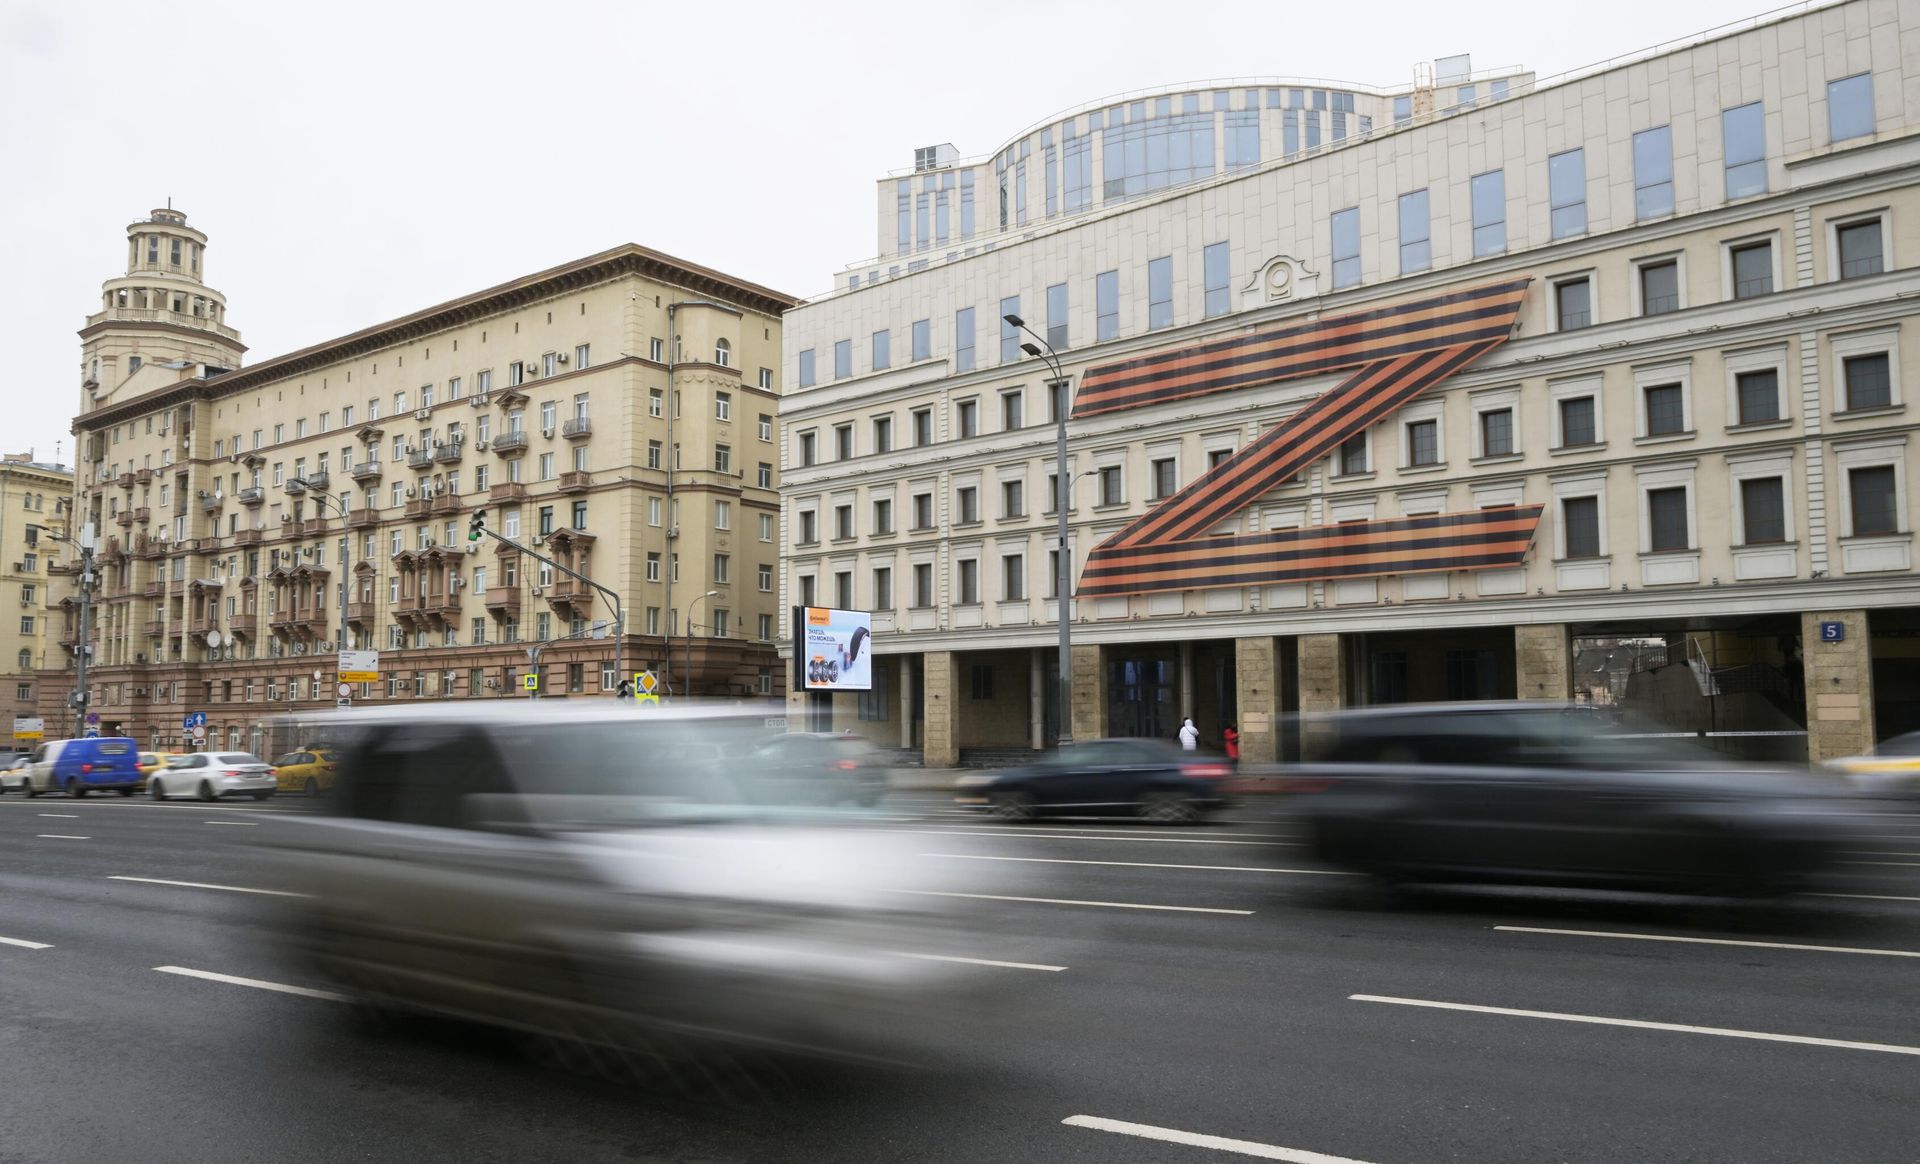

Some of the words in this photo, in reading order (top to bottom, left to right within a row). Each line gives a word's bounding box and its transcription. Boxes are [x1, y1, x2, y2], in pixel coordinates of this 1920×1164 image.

[1070, 275, 1546, 599] Z
[1826, 625, 1837, 638] 5
[767, 719, 785, 727] СТОП
